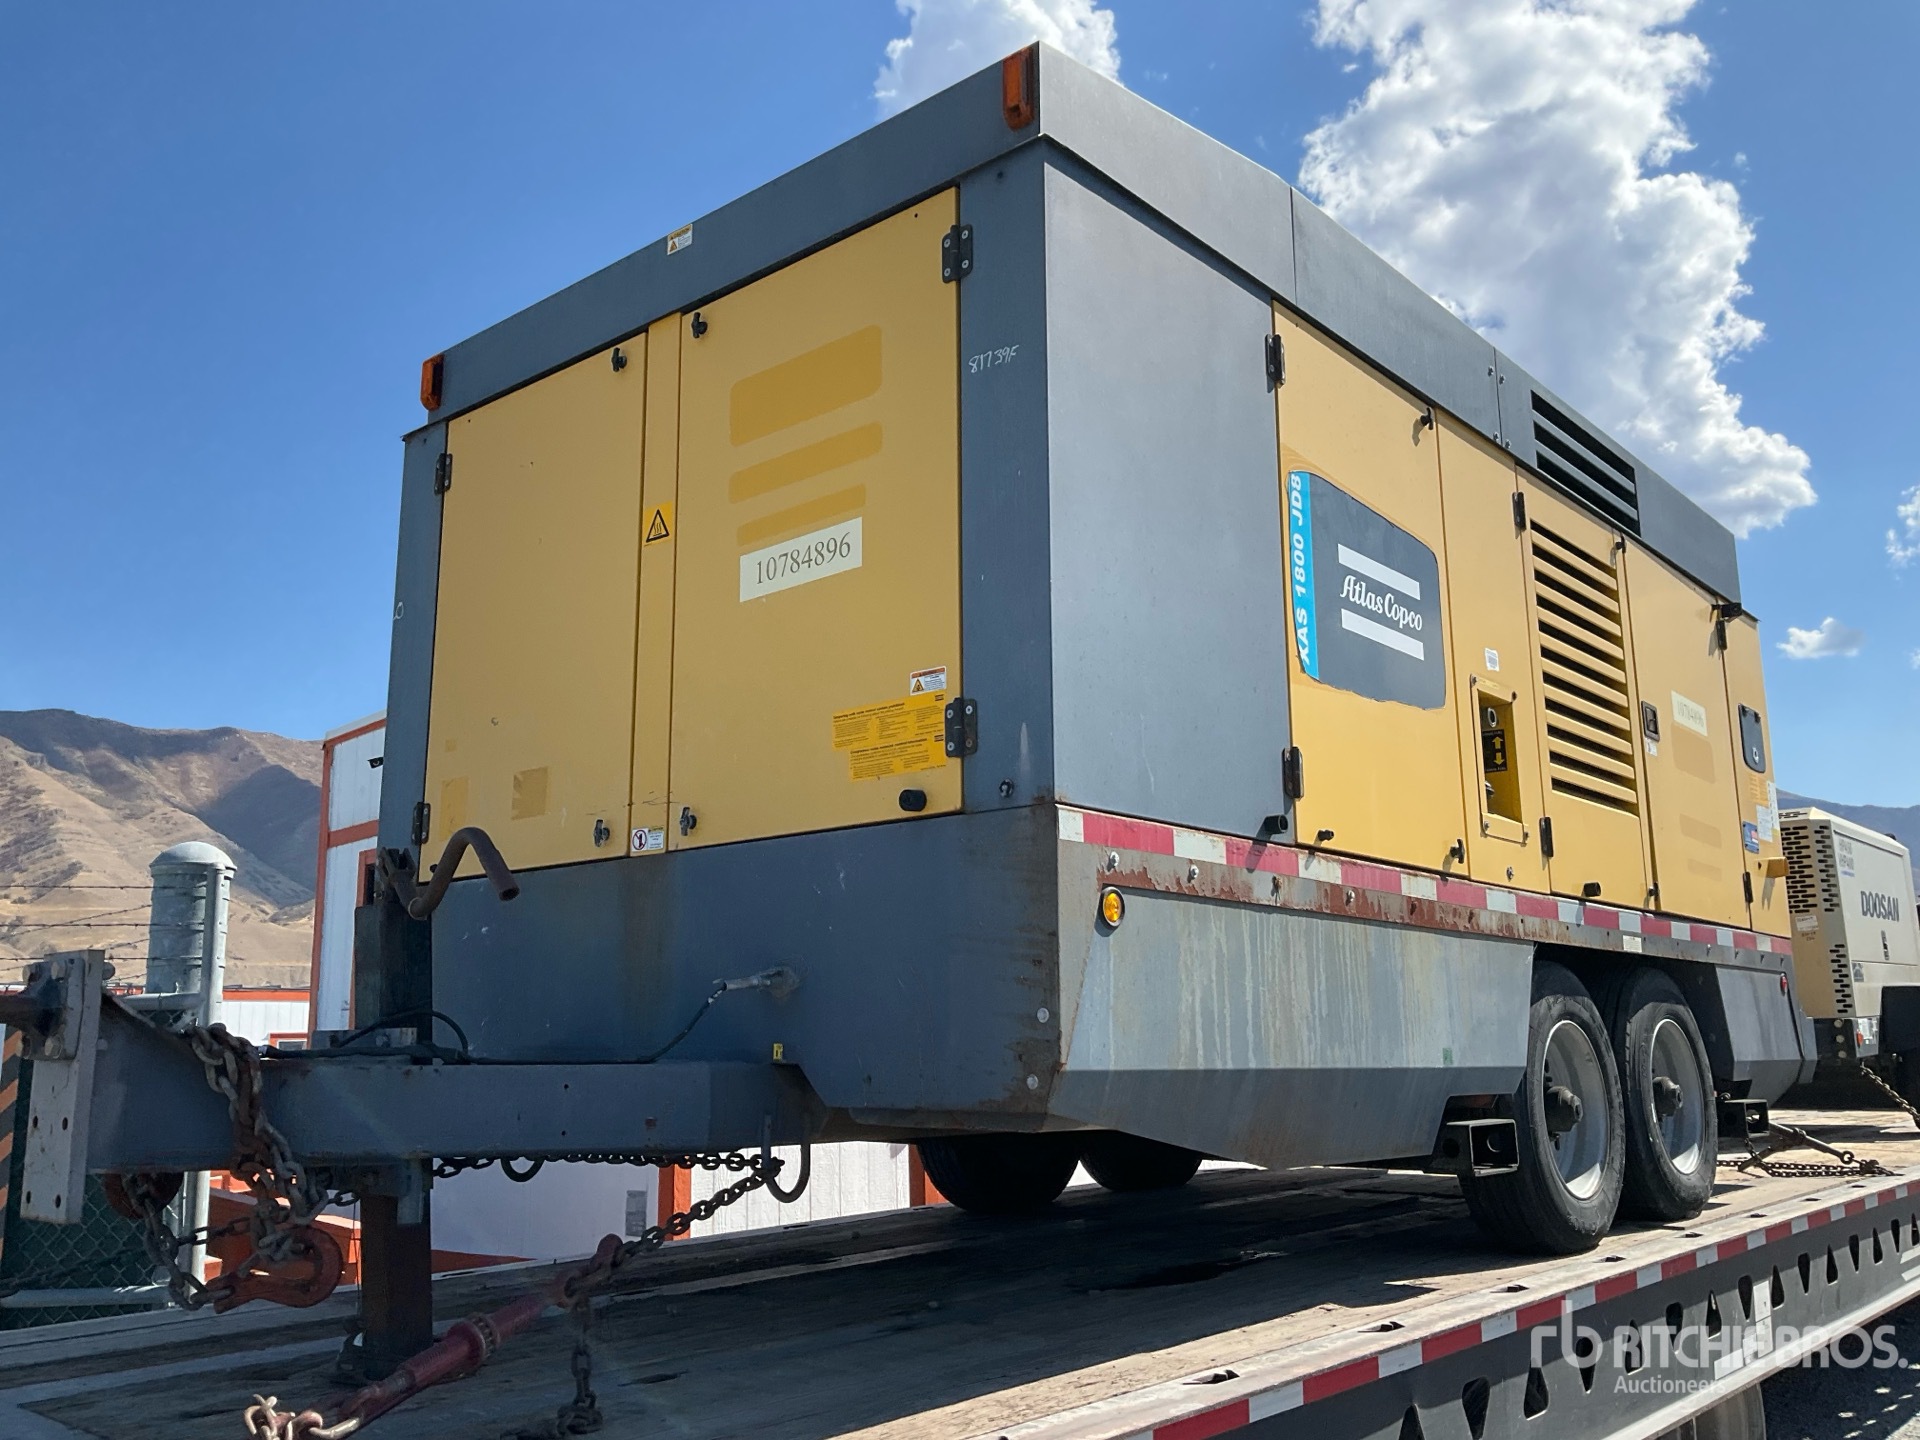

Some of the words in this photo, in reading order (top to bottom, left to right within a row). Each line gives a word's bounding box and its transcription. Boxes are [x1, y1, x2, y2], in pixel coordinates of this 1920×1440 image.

[1291, 473, 1303, 527] JD8
[756, 531, 851, 585] 10784896
[1293, 532, 1306, 598] 1800
[1340, 574, 1383, 614] Atlas
[1384, 592, 1422, 631] Copco
[1296, 607, 1310, 666] XAS
[1860, 890, 1900, 922] DOOSAN
